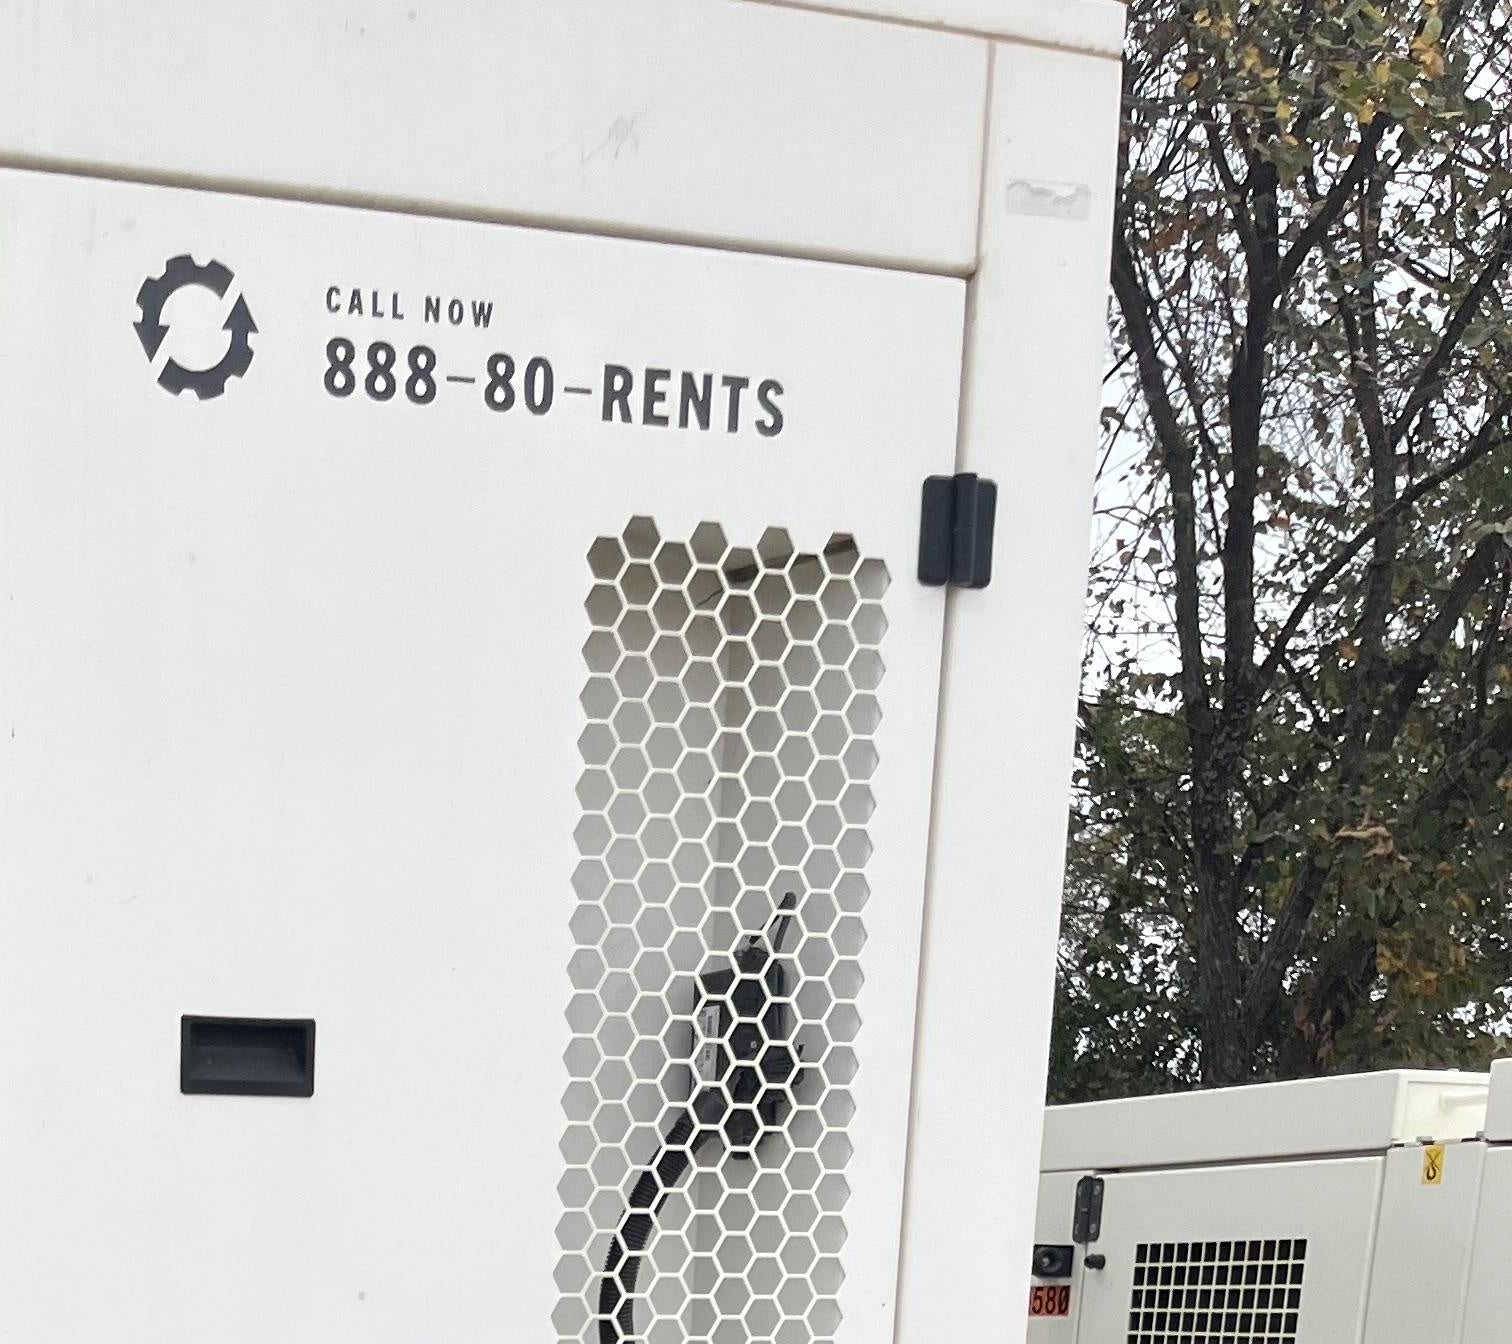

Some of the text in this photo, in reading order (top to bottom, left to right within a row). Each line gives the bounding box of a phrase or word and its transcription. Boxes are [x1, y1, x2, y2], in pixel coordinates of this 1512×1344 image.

[325, 285, 495, 328] CALL NOW
[322, 336, 786, 438] 888-80-RENTS
